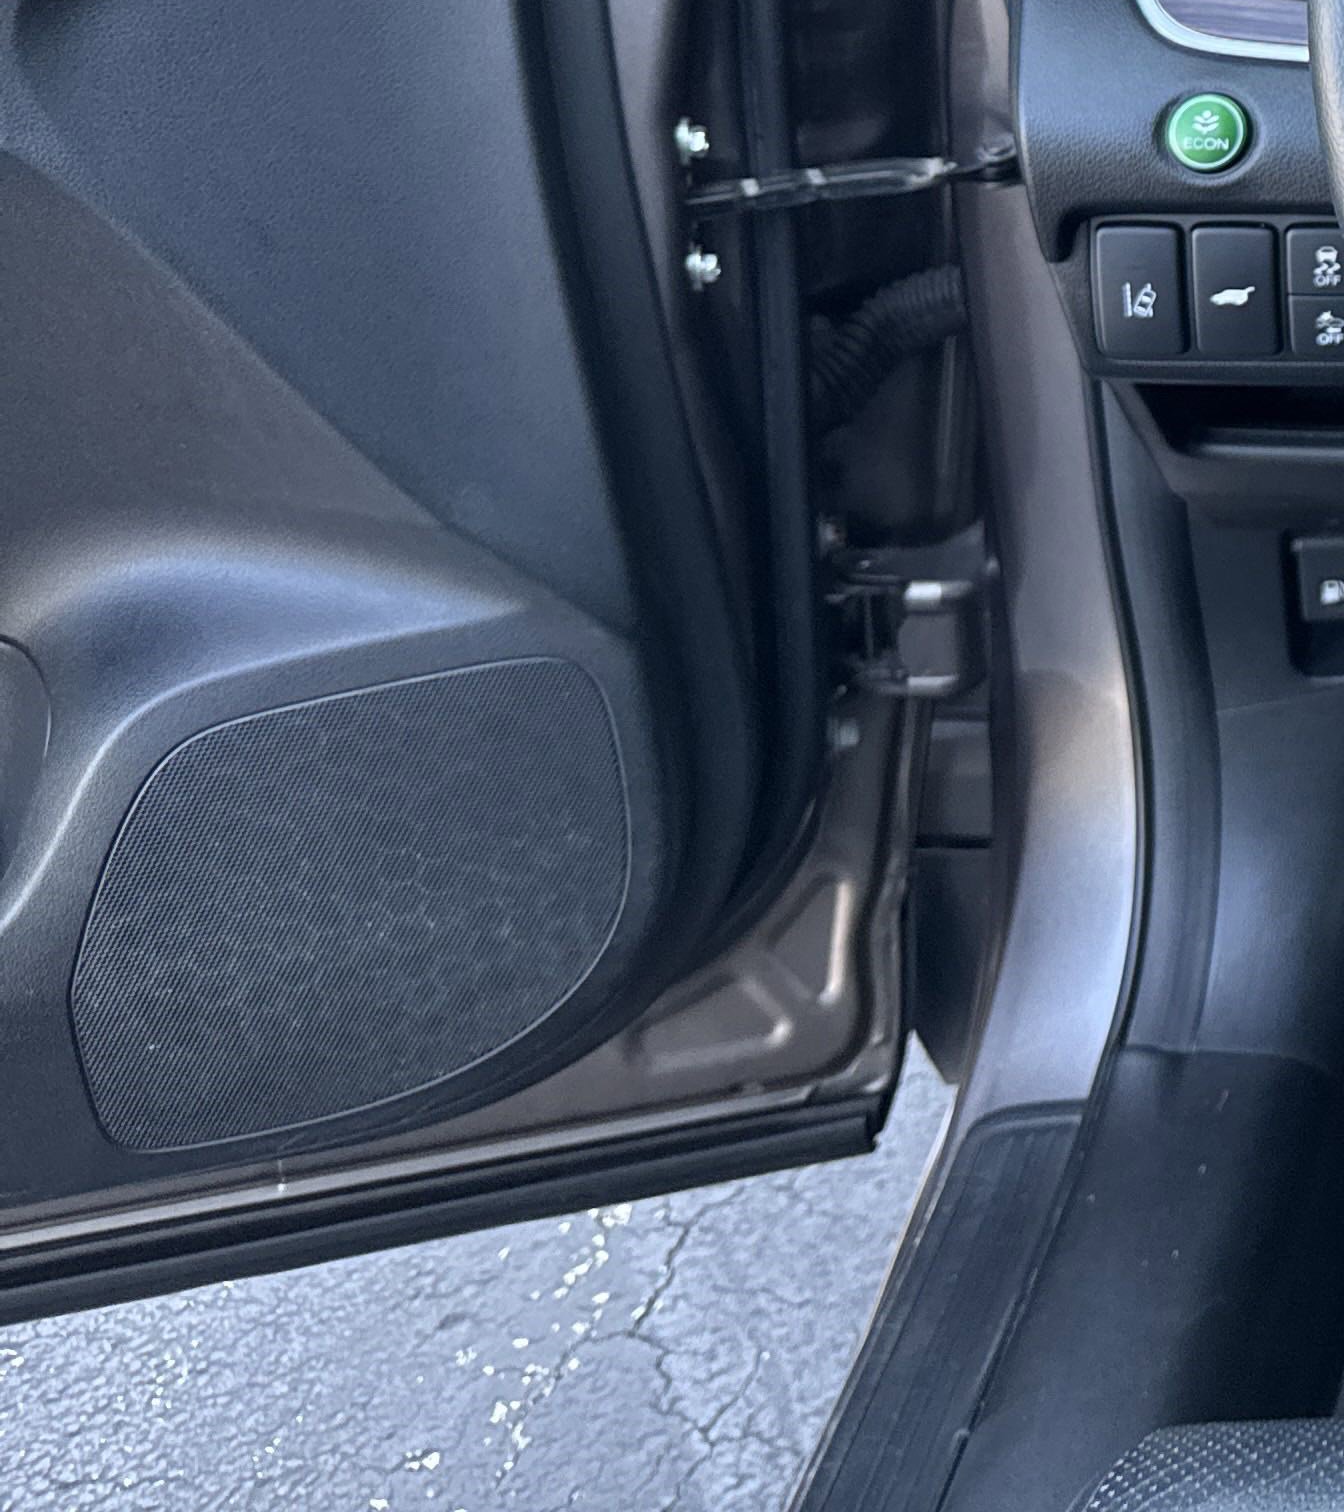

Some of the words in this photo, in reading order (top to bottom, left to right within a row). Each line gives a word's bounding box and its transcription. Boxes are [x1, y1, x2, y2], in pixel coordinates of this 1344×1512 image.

[1183, 138, 1229, 151] ECON
[1313, 275, 1341, 287] OFF
[1316, 333, 1344, 345] OFF
